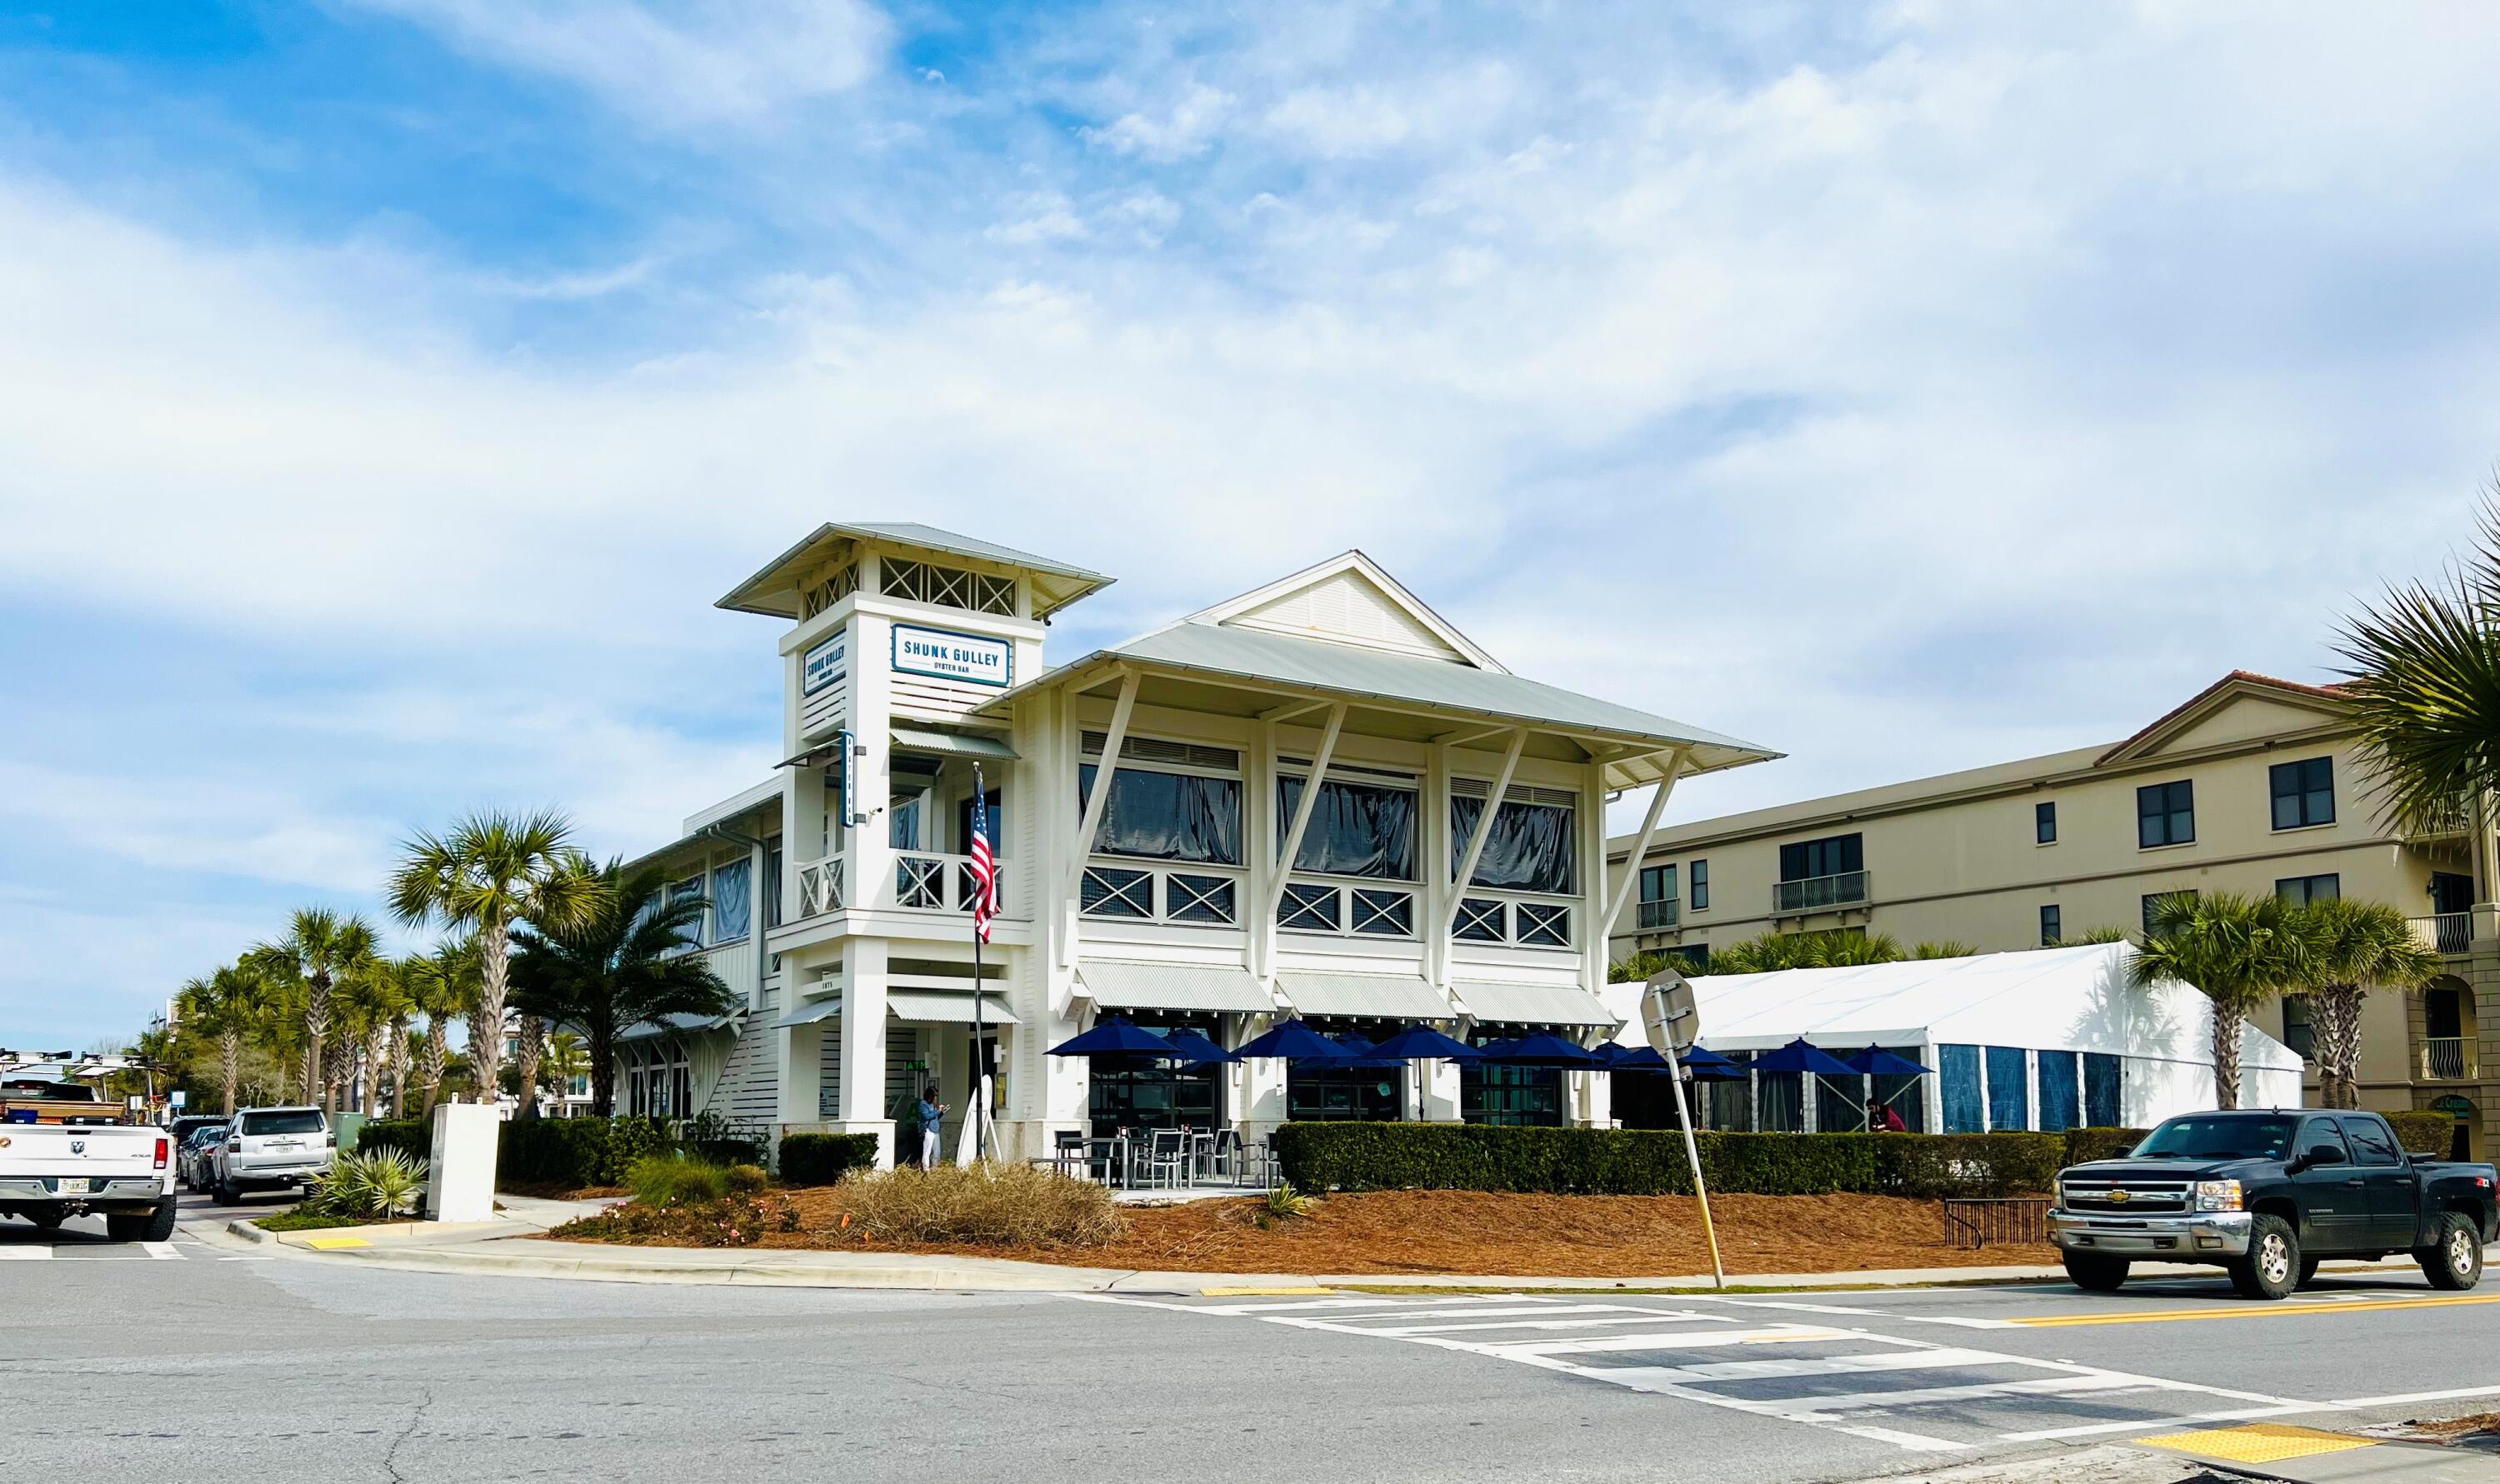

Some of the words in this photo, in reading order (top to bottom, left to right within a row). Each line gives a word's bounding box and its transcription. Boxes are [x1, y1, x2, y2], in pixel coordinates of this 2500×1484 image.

[904, 641, 948, 659] SHUNK
[953, 648, 998, 667] GULLEY
[934, 662, 956, 672] OYSTER
